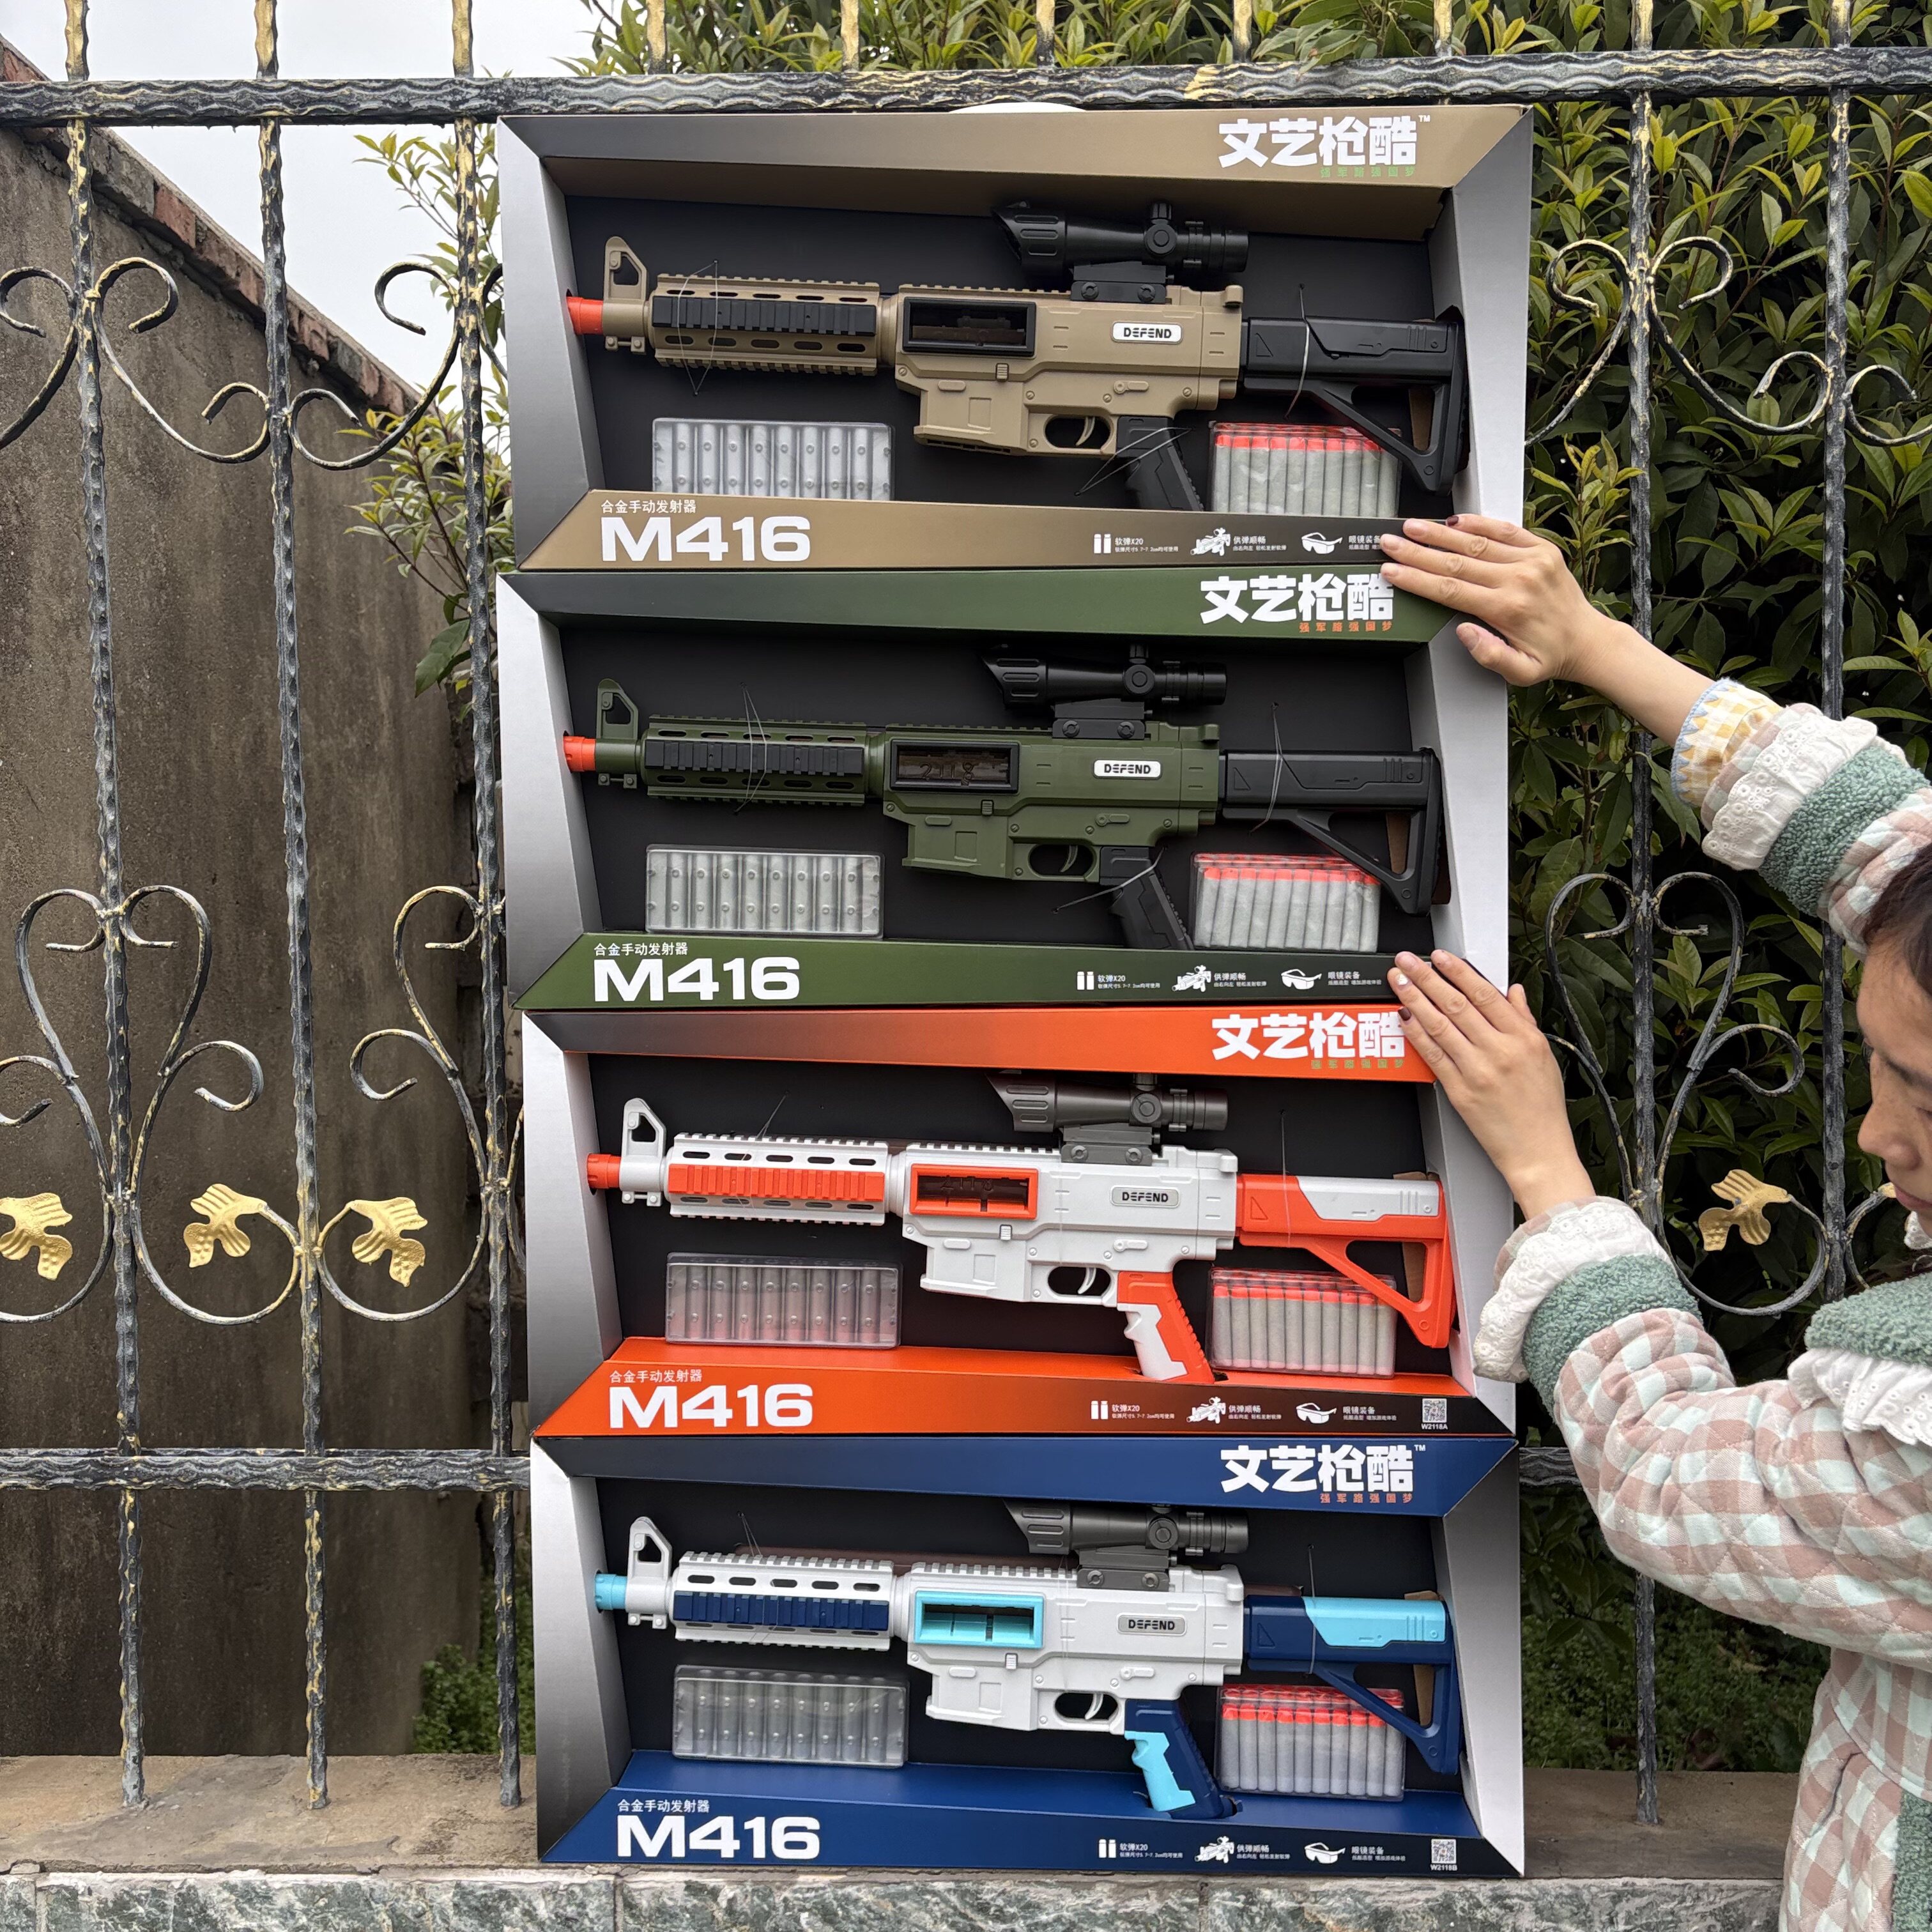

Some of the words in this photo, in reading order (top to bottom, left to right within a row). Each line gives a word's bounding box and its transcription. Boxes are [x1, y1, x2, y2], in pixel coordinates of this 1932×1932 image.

[1218, 115, 1417, 168] 文艺枪酷
[1123, 327, 1172, 339] DEFEND
[601, 499, 696, 514] 合金手动发射器
[601, 516, 811, 562] M416
[1200, 573, 1394, 624] 文艺枪酷
[1299, 620, 1393, 632] 强军路强国梦
[1104, 763, 1151, 774] DEFEND
[594, 942, 688, 956] 合金手动发射器
[594, 957, 800, 1002] M416
[1211, 1012, 1405, 1061] 文艺枪酷
[1122, 1192, 1169, 1202] DEFEND
[610, 1368, 702, 1383] 合金手动发射器
[609, 1383, 813, 1429] M416
[1220, 1445, 1414, 1493] 文艺枪酷
[1320, 1493, 1413, 1503] 强军路强国梦
[1128, 1620, 1175, 1630] DEFEND
[617, 1798, 710, 1813] 合金手动发射器
[617, 1815, 820, 1859] M416
